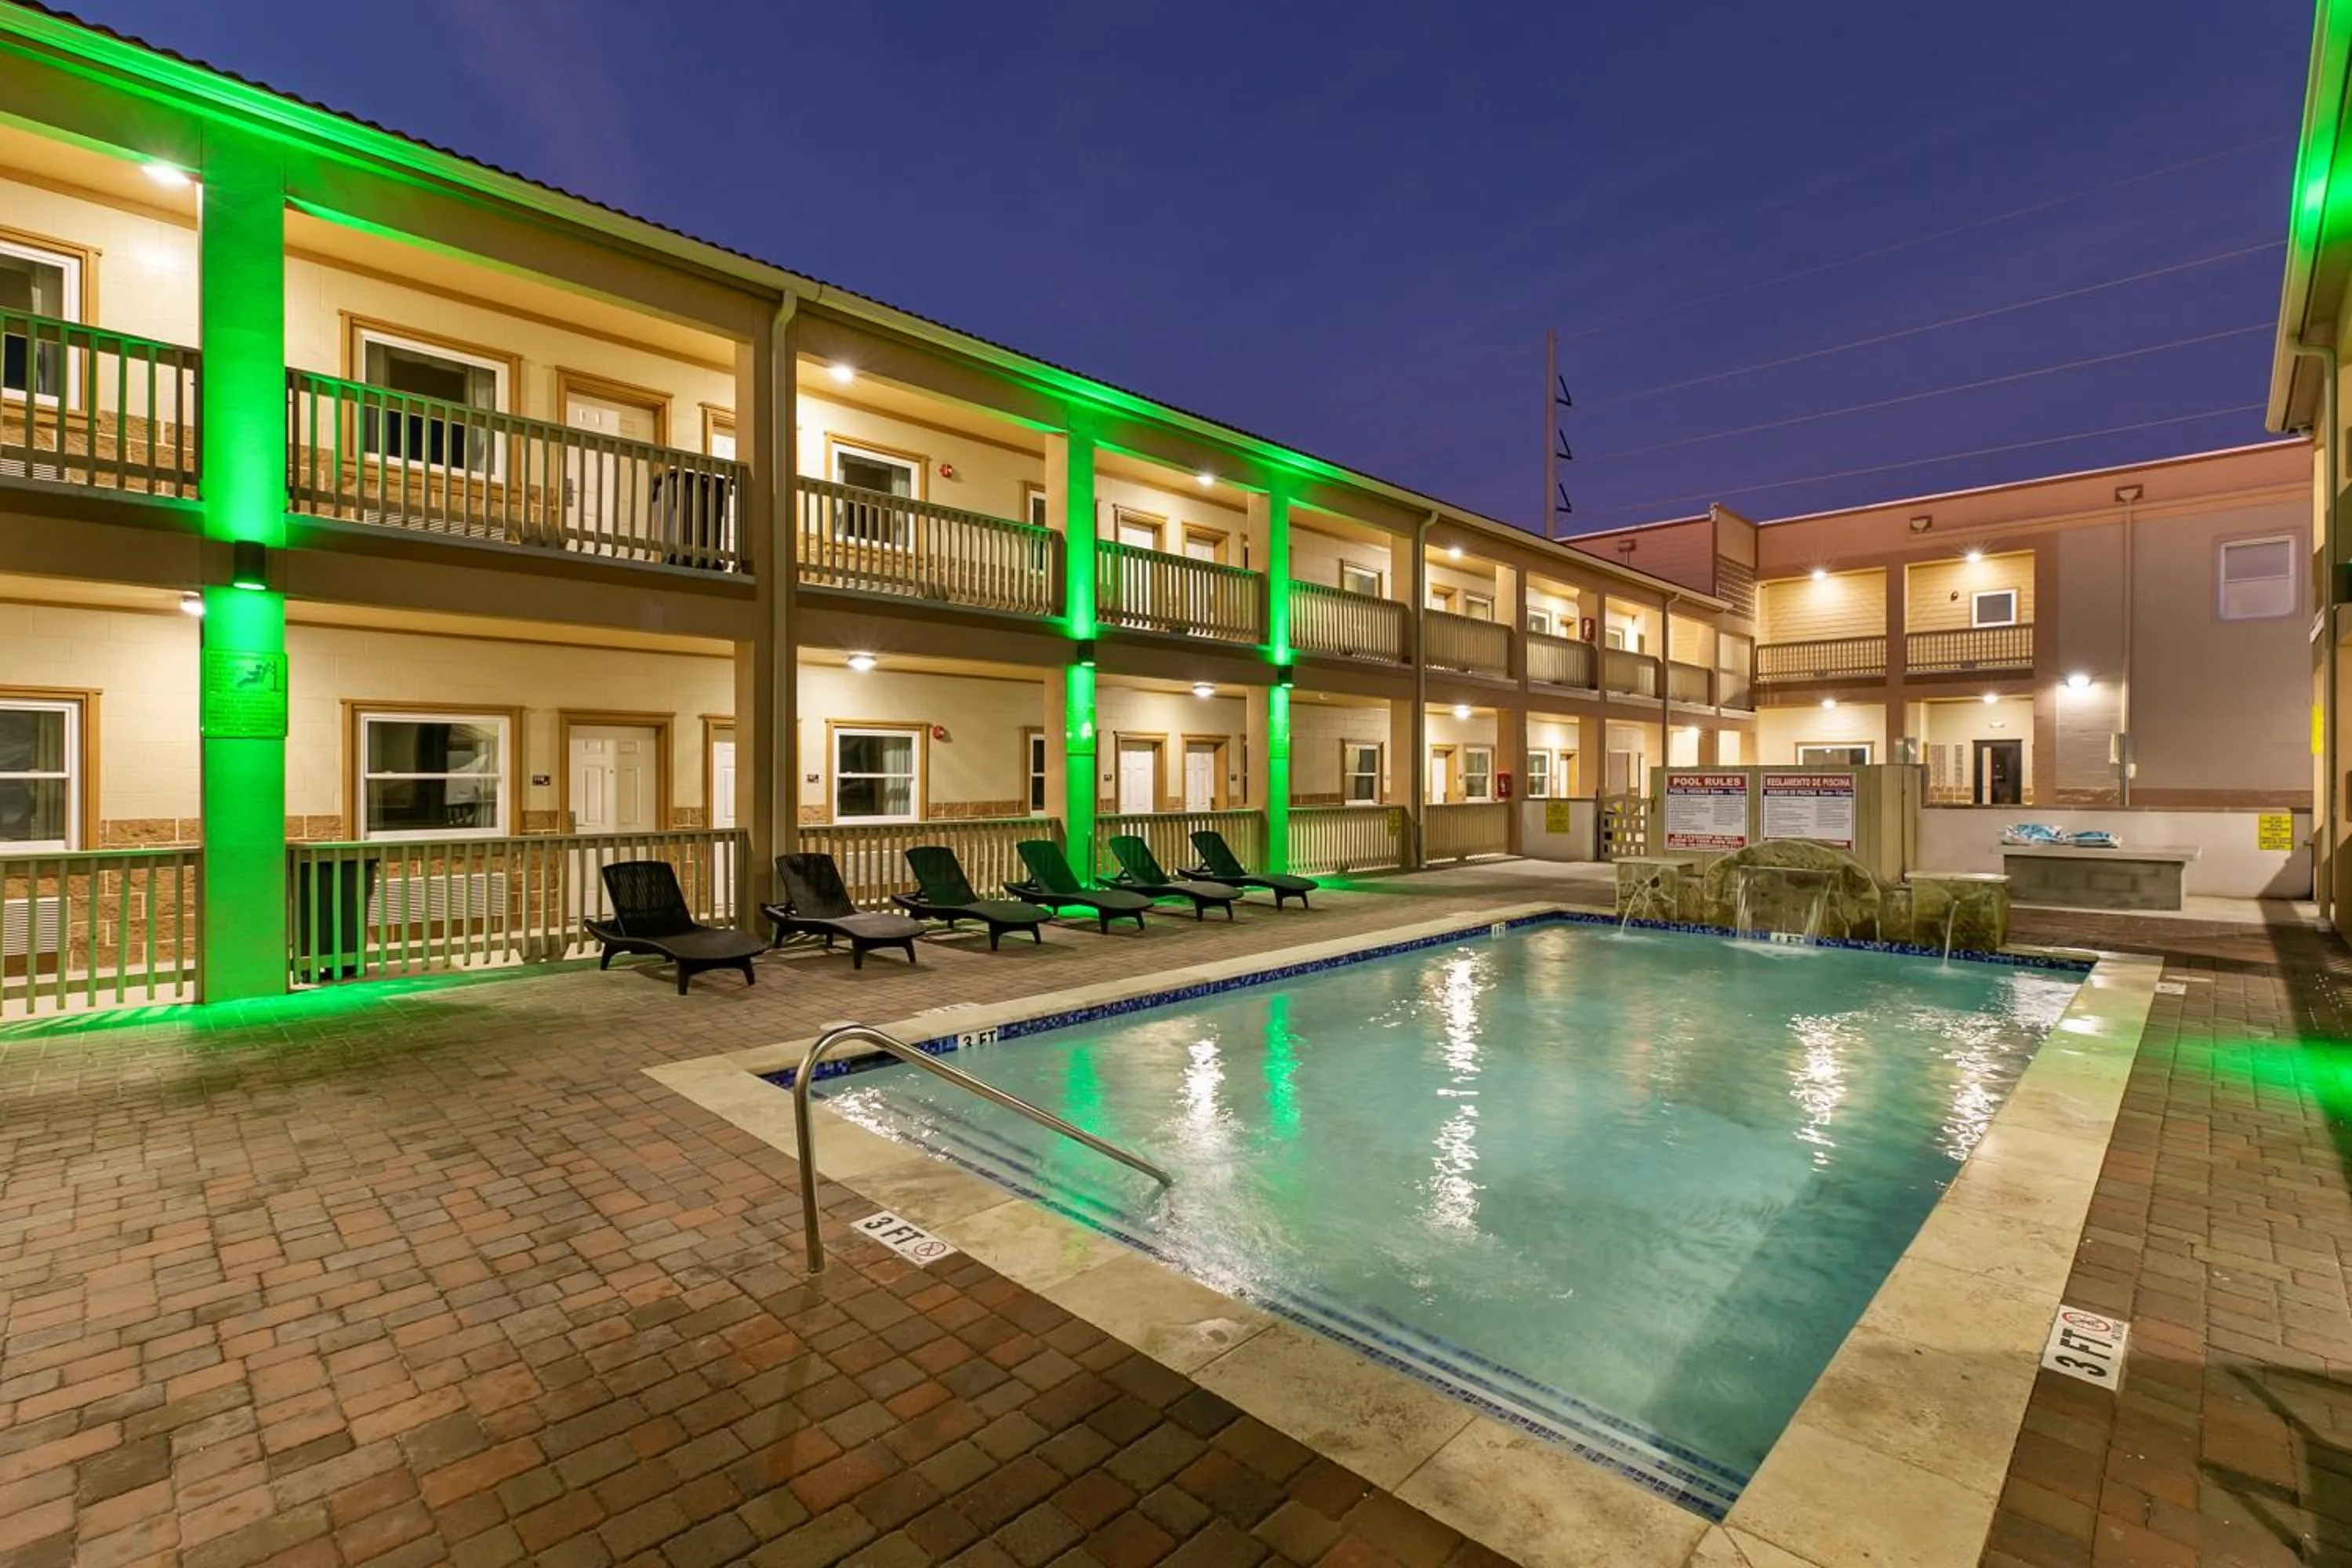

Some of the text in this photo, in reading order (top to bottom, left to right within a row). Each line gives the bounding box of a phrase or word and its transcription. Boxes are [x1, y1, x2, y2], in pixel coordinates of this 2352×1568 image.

[1673, 777, 1741, 787] POOL RULES
[1812, 777, 1821, 787] DE
[1823, 777, 1850, 787] PISCINA
[978, 1030, 996, 1045] FT
[864, 1217, 926, 1245] 3 FT
[2054, 1328, 2113, 1377] 3 FT
